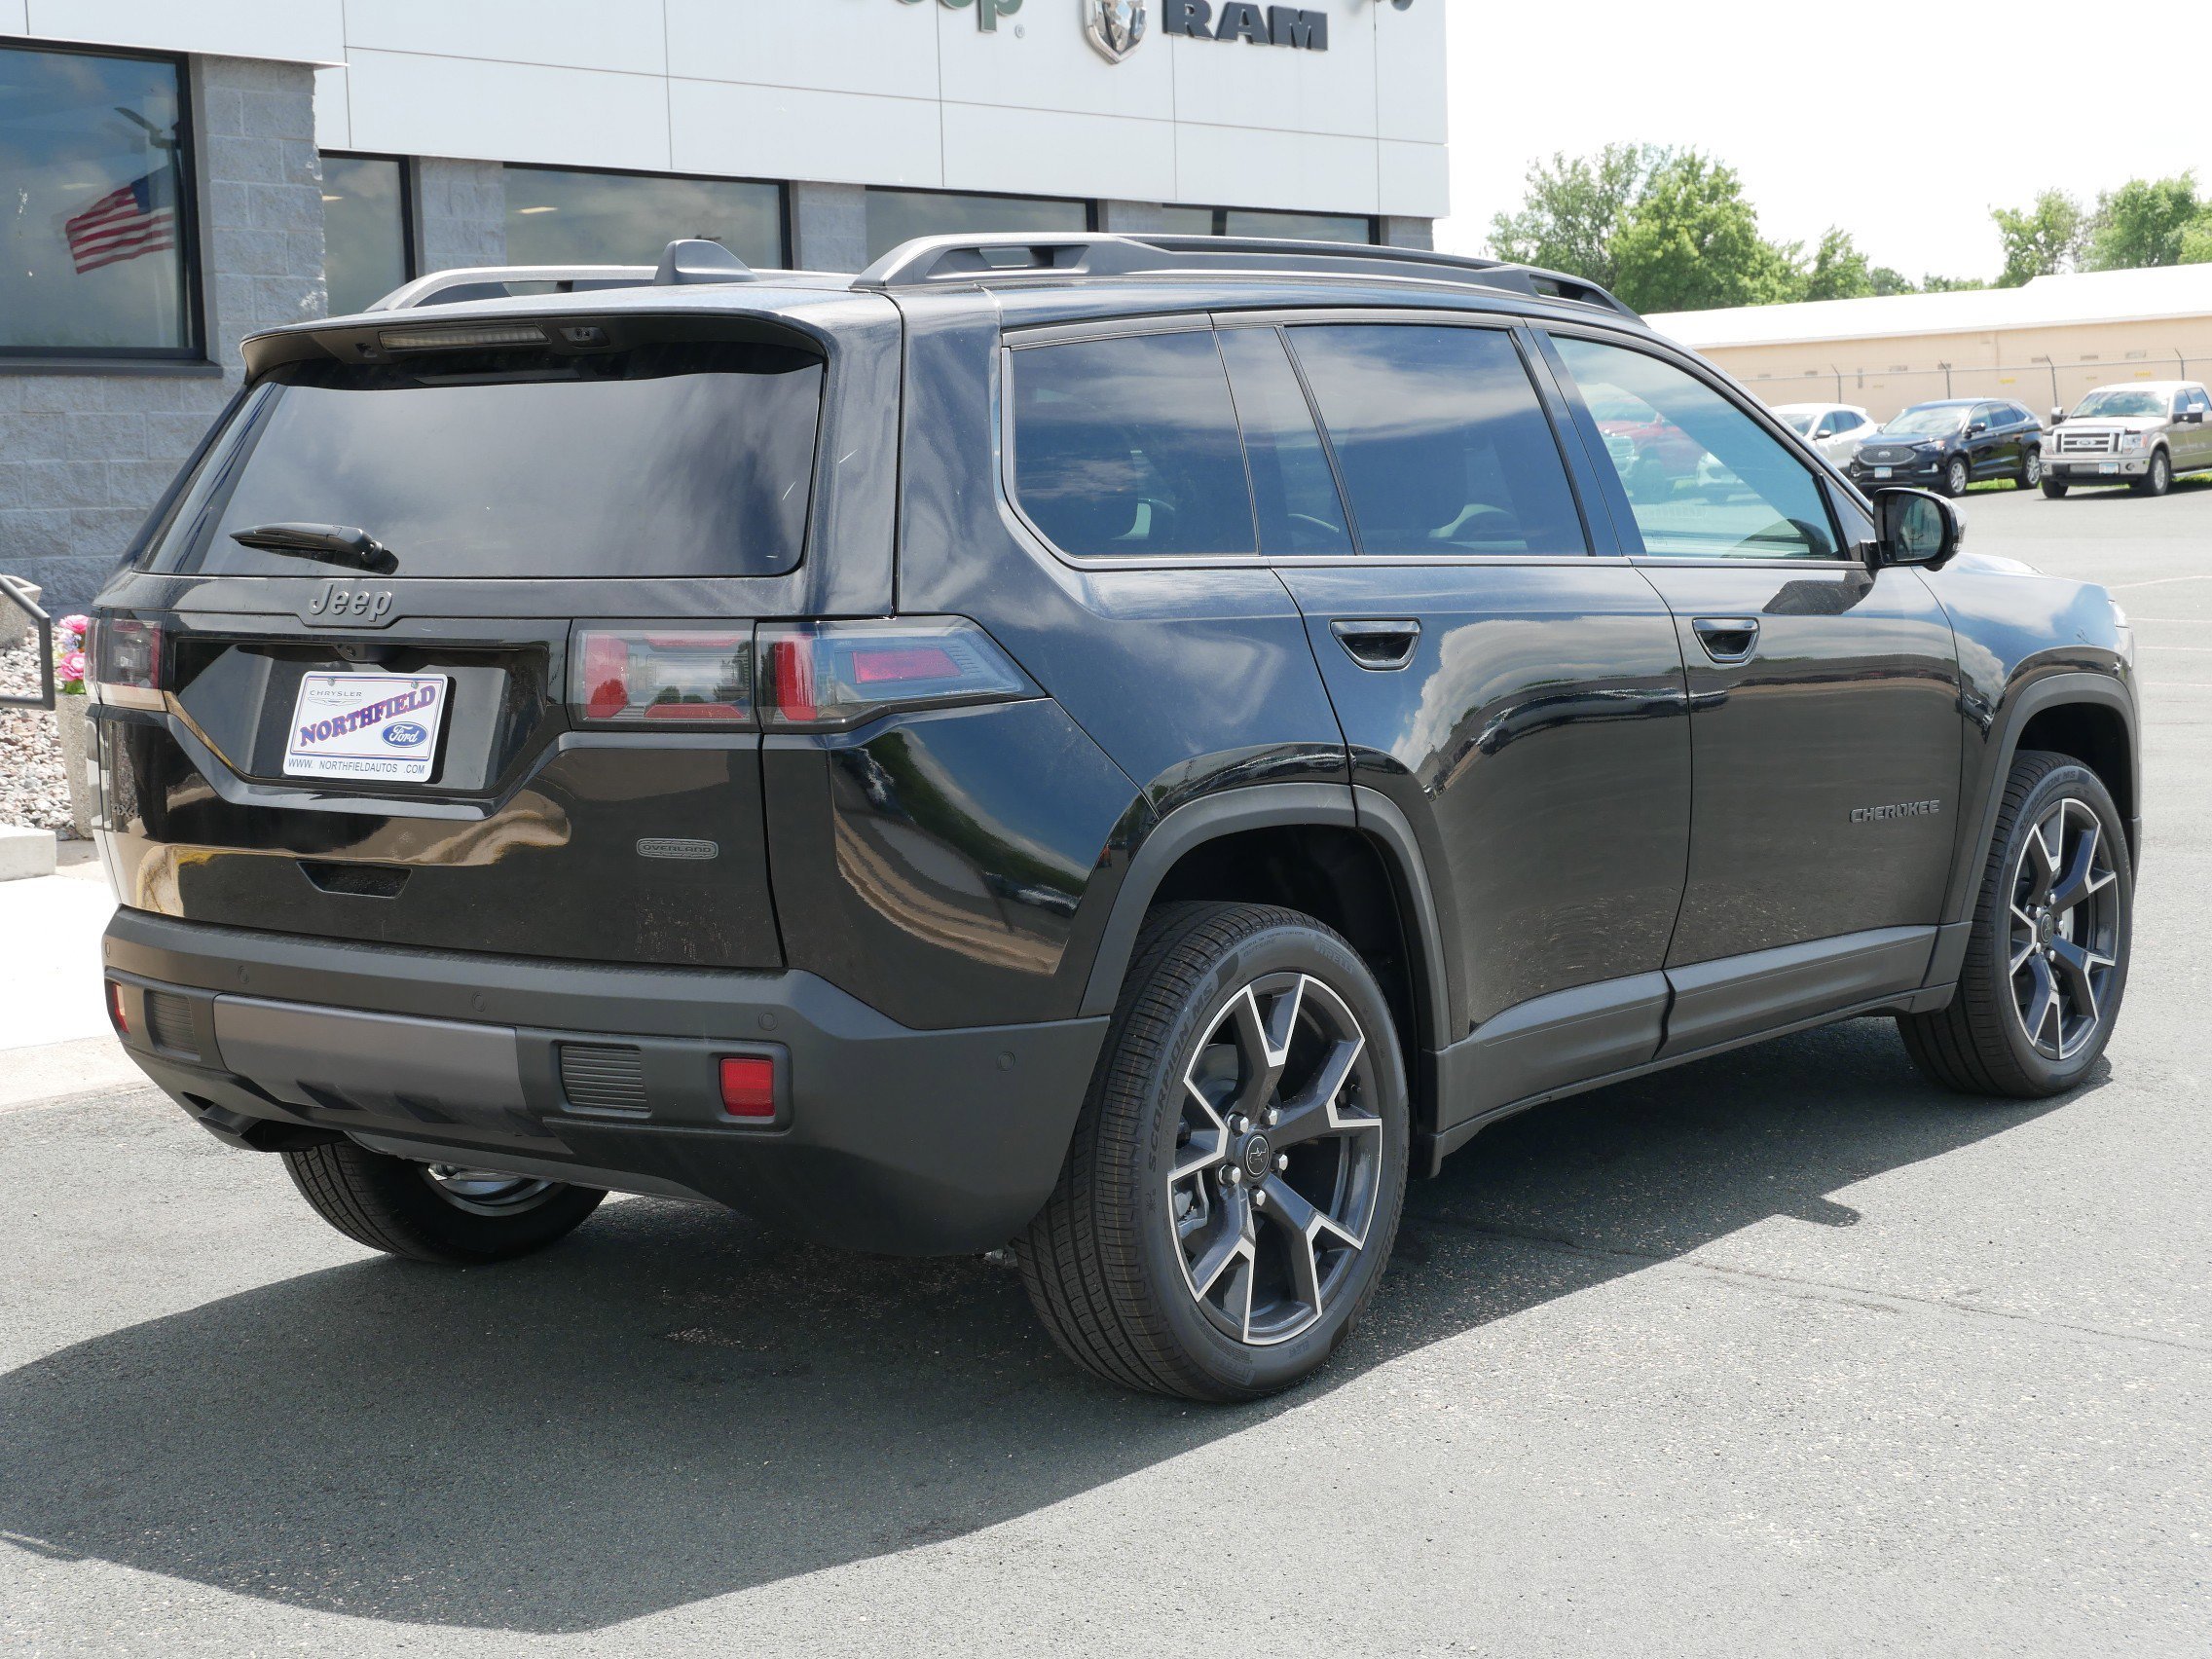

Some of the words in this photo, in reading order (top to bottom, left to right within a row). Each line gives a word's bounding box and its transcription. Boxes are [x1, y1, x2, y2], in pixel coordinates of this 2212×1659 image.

[1161, 0, 1328, 51] RAM
[309, 583, 393, 622] Jeep
[300, 684, 436, 747] NORTHFIELD
[388, 723, 419, 744] Ford
[319, 760, 398, 773] NORTHFIELDAUTOS
[1850, 799, 1940, 824] CHEROKEE
[643, 844, 712, 853] OVERLAND
